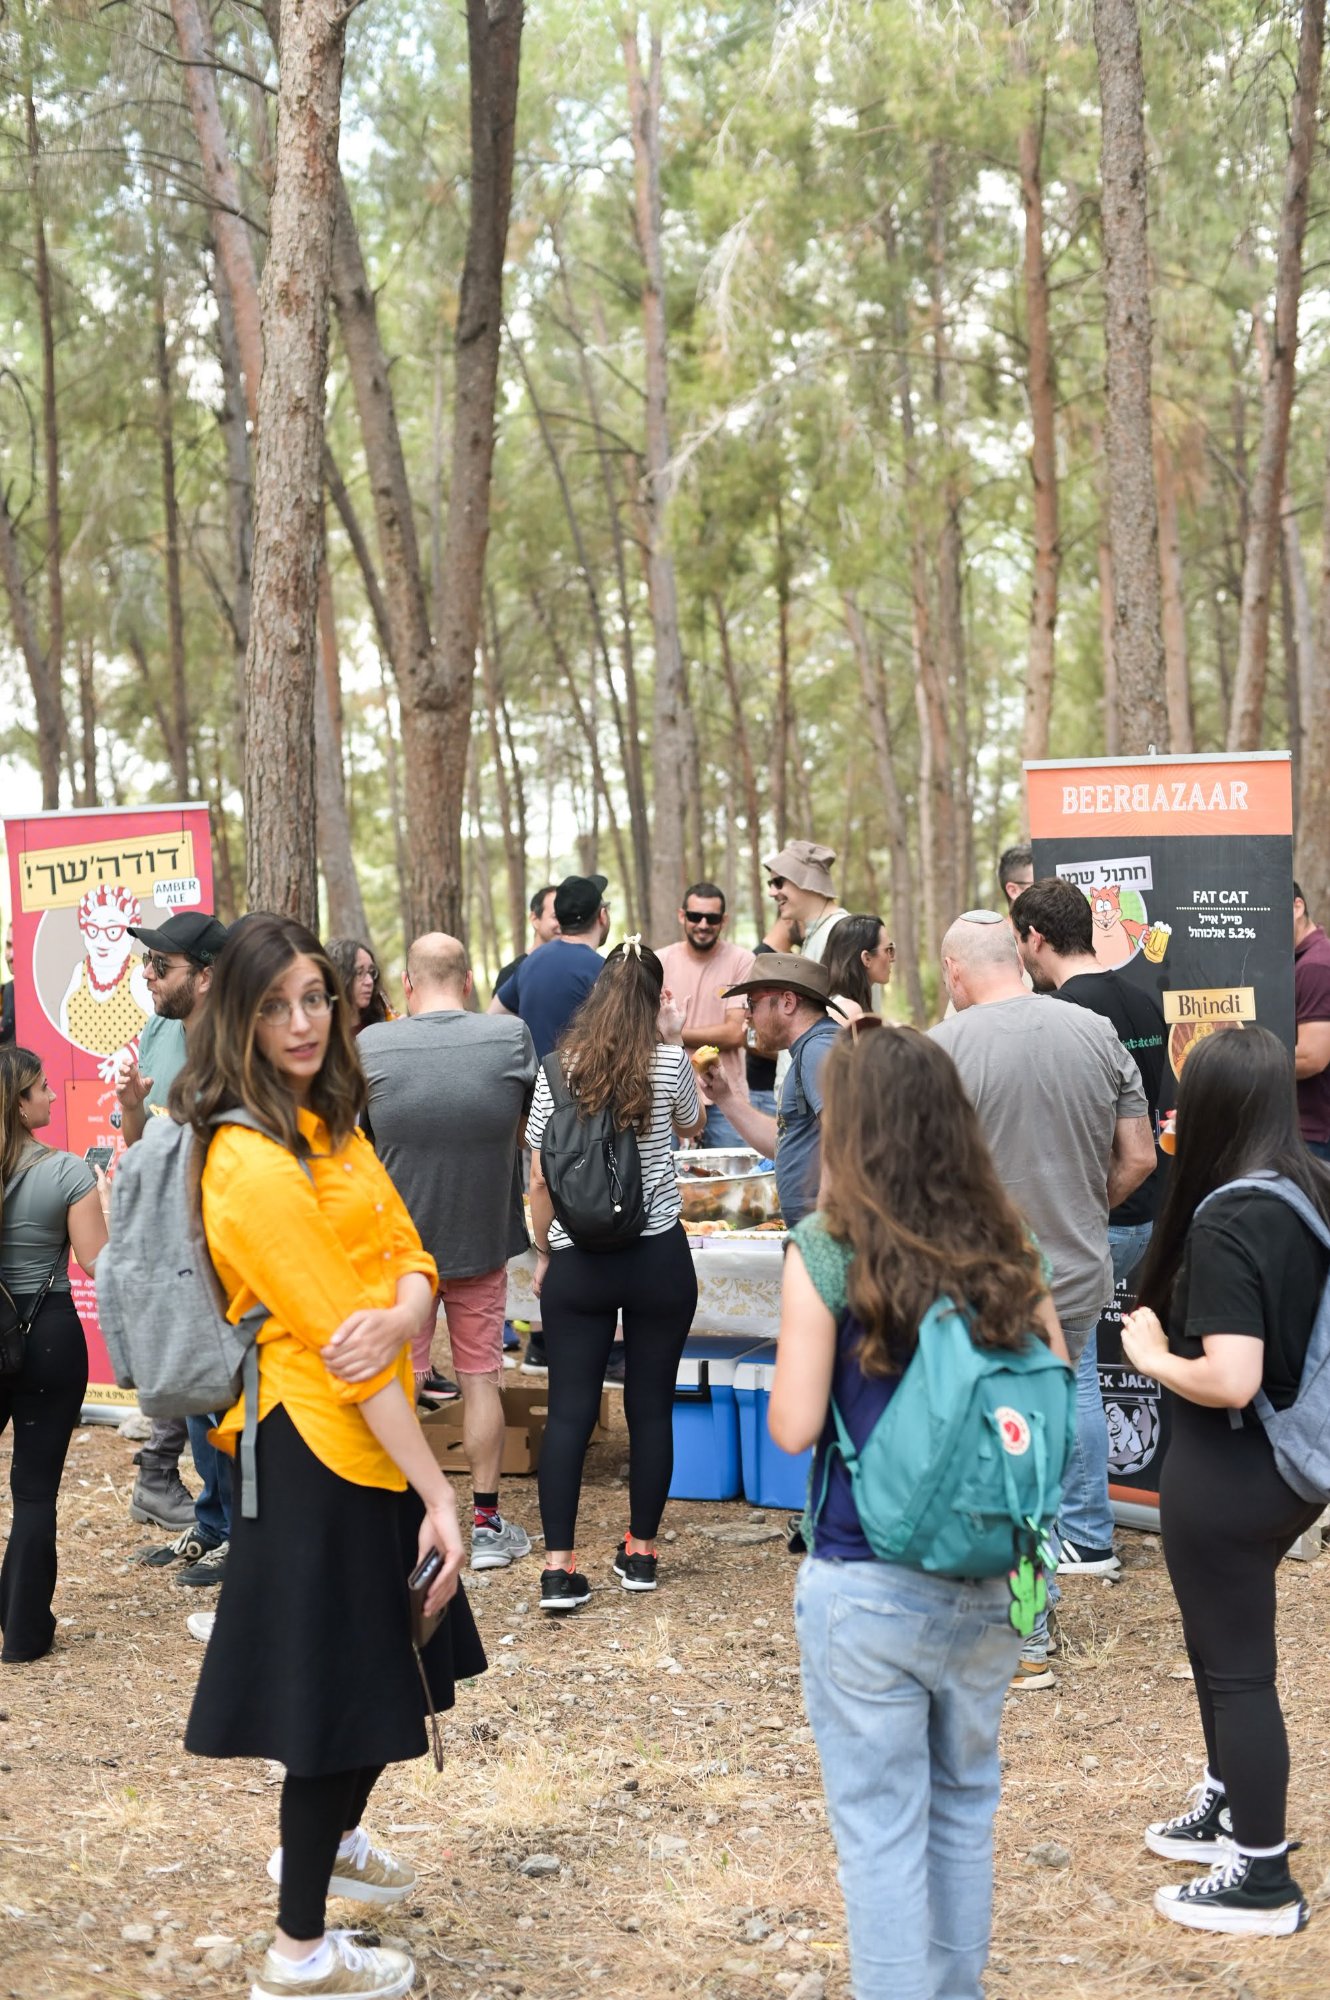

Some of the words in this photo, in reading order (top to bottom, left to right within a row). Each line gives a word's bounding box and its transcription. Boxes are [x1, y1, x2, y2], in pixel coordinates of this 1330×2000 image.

[1062, 781, 1248, 814] BEERBAZAAR
[1100, 865, 1147, 883] חתול
[155, 880, 197, 894] AMBER
[166, 893, 185, 904] ALE
[1192, 890, 1217, 904] FAT
[1218, 890, 1249, 904] CAT
[1198, 913, 1218, 925] אייל
[1220, 913, 1242, 925] פייל
[1188, 926, 1226, 938] אלכוהול
[1228, 927, 1256, 939] 5.2%
[1177, 994, 1244, 1018] Bhindi
[1118, 1372, 1156, 1389] JACK
